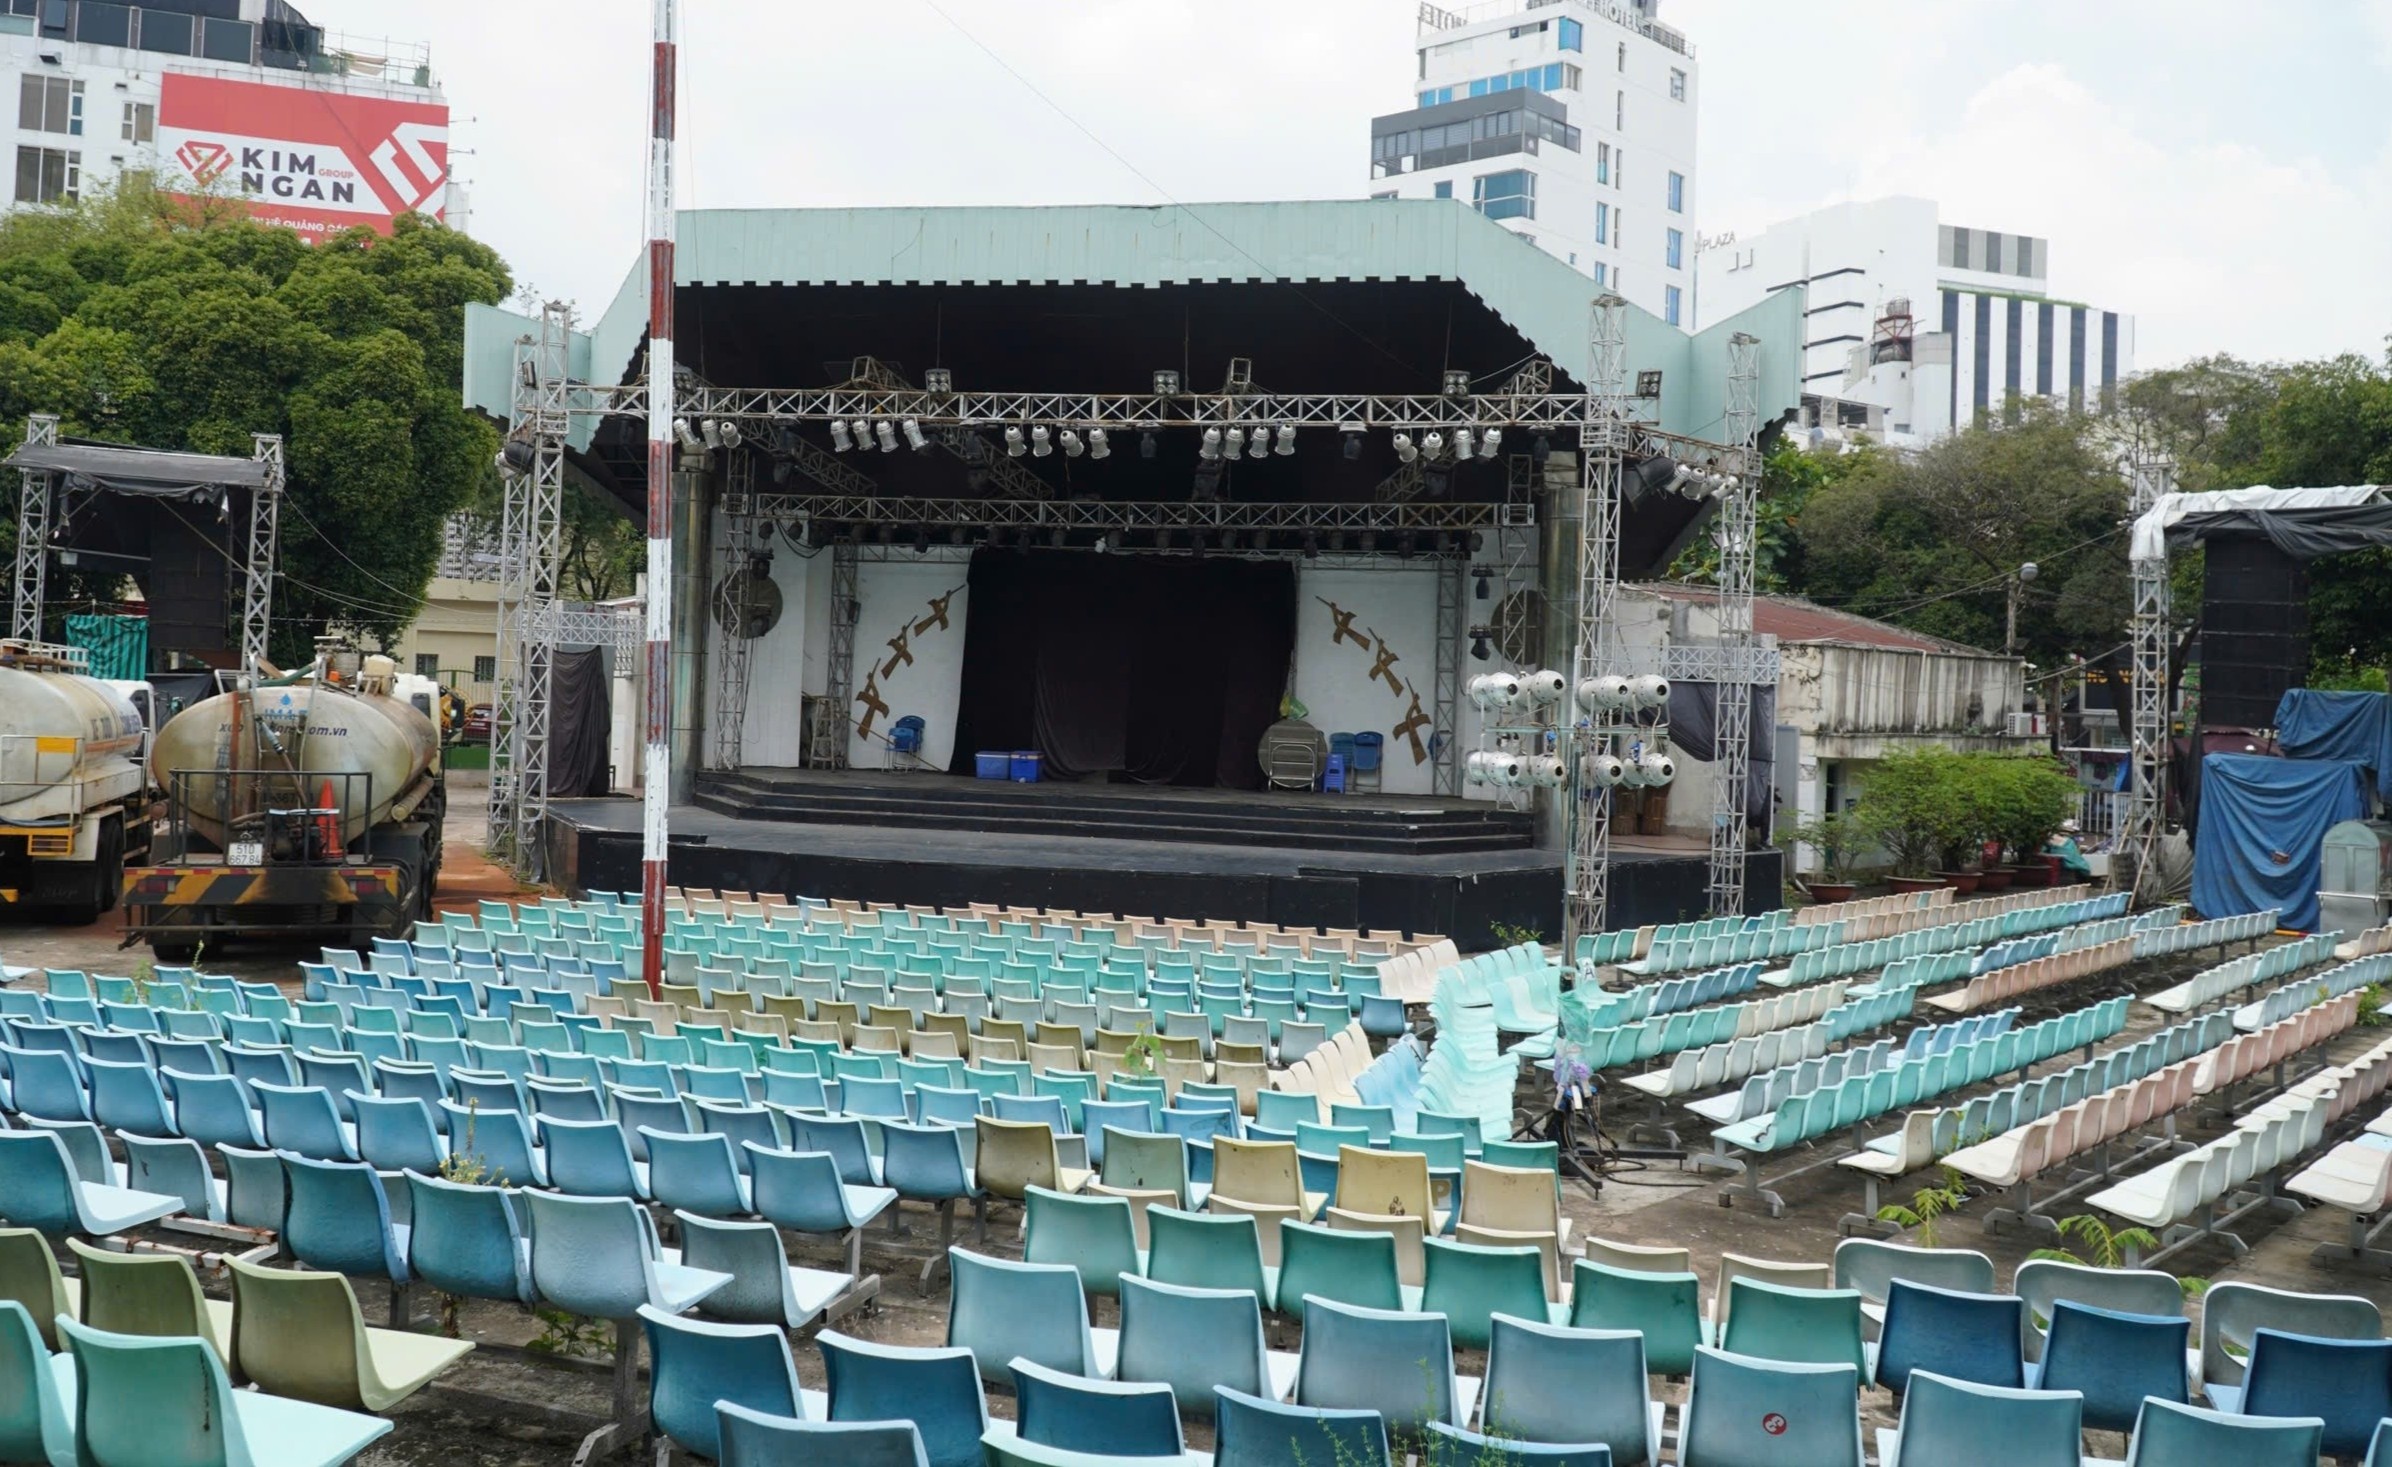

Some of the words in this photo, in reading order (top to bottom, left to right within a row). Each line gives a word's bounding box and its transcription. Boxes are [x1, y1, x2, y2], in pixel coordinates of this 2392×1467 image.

[242, 147, 315, 175] KIM
[318, 168, 354, 179] GROUP
[241, 171, 354, 203] NGAN
[1702, 230, 1736, 252] PLAZA
